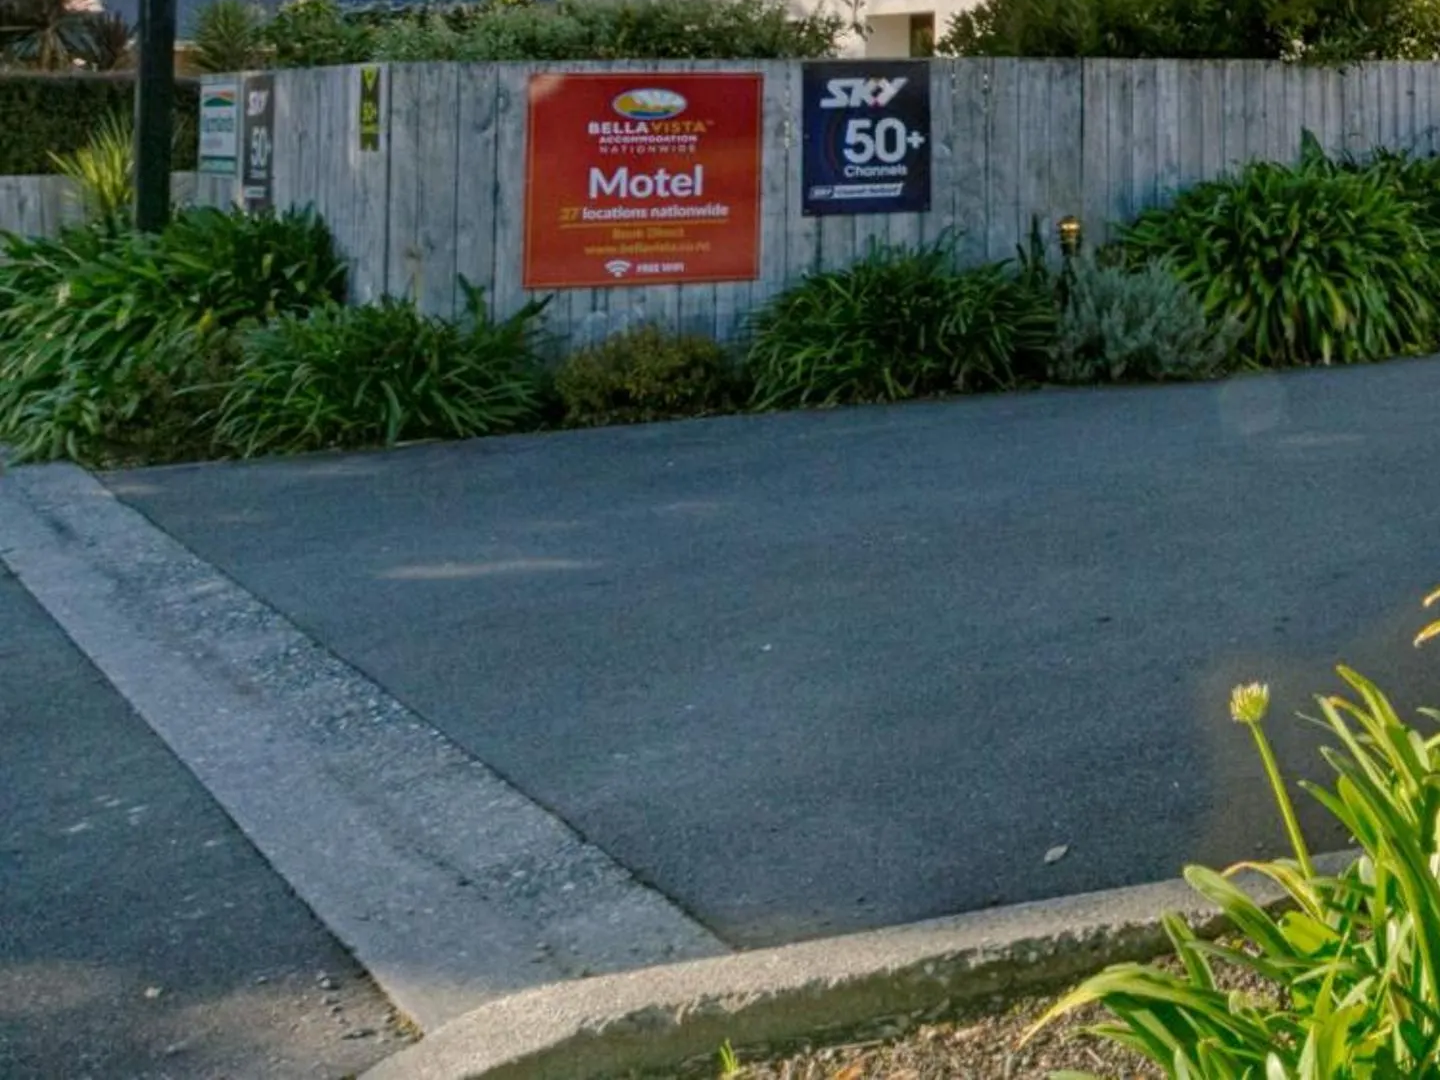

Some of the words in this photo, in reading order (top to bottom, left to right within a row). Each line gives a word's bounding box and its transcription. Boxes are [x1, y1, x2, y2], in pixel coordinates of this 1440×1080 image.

[820, 77, 907, 108] SKY
[588, 120, 649, 134] BELLA
[651, 119, 707, 132] VISTA
[599, 134, 698, 144] ACCOMMODATION
[843, 117, 925, 163] 50+
[600, 145, 696, 154] NATIONWIDE
[588, 164, 703, 199] Motel
[582, 206, 647, 220] locations
[650, 203, 729, 218] nationwide
